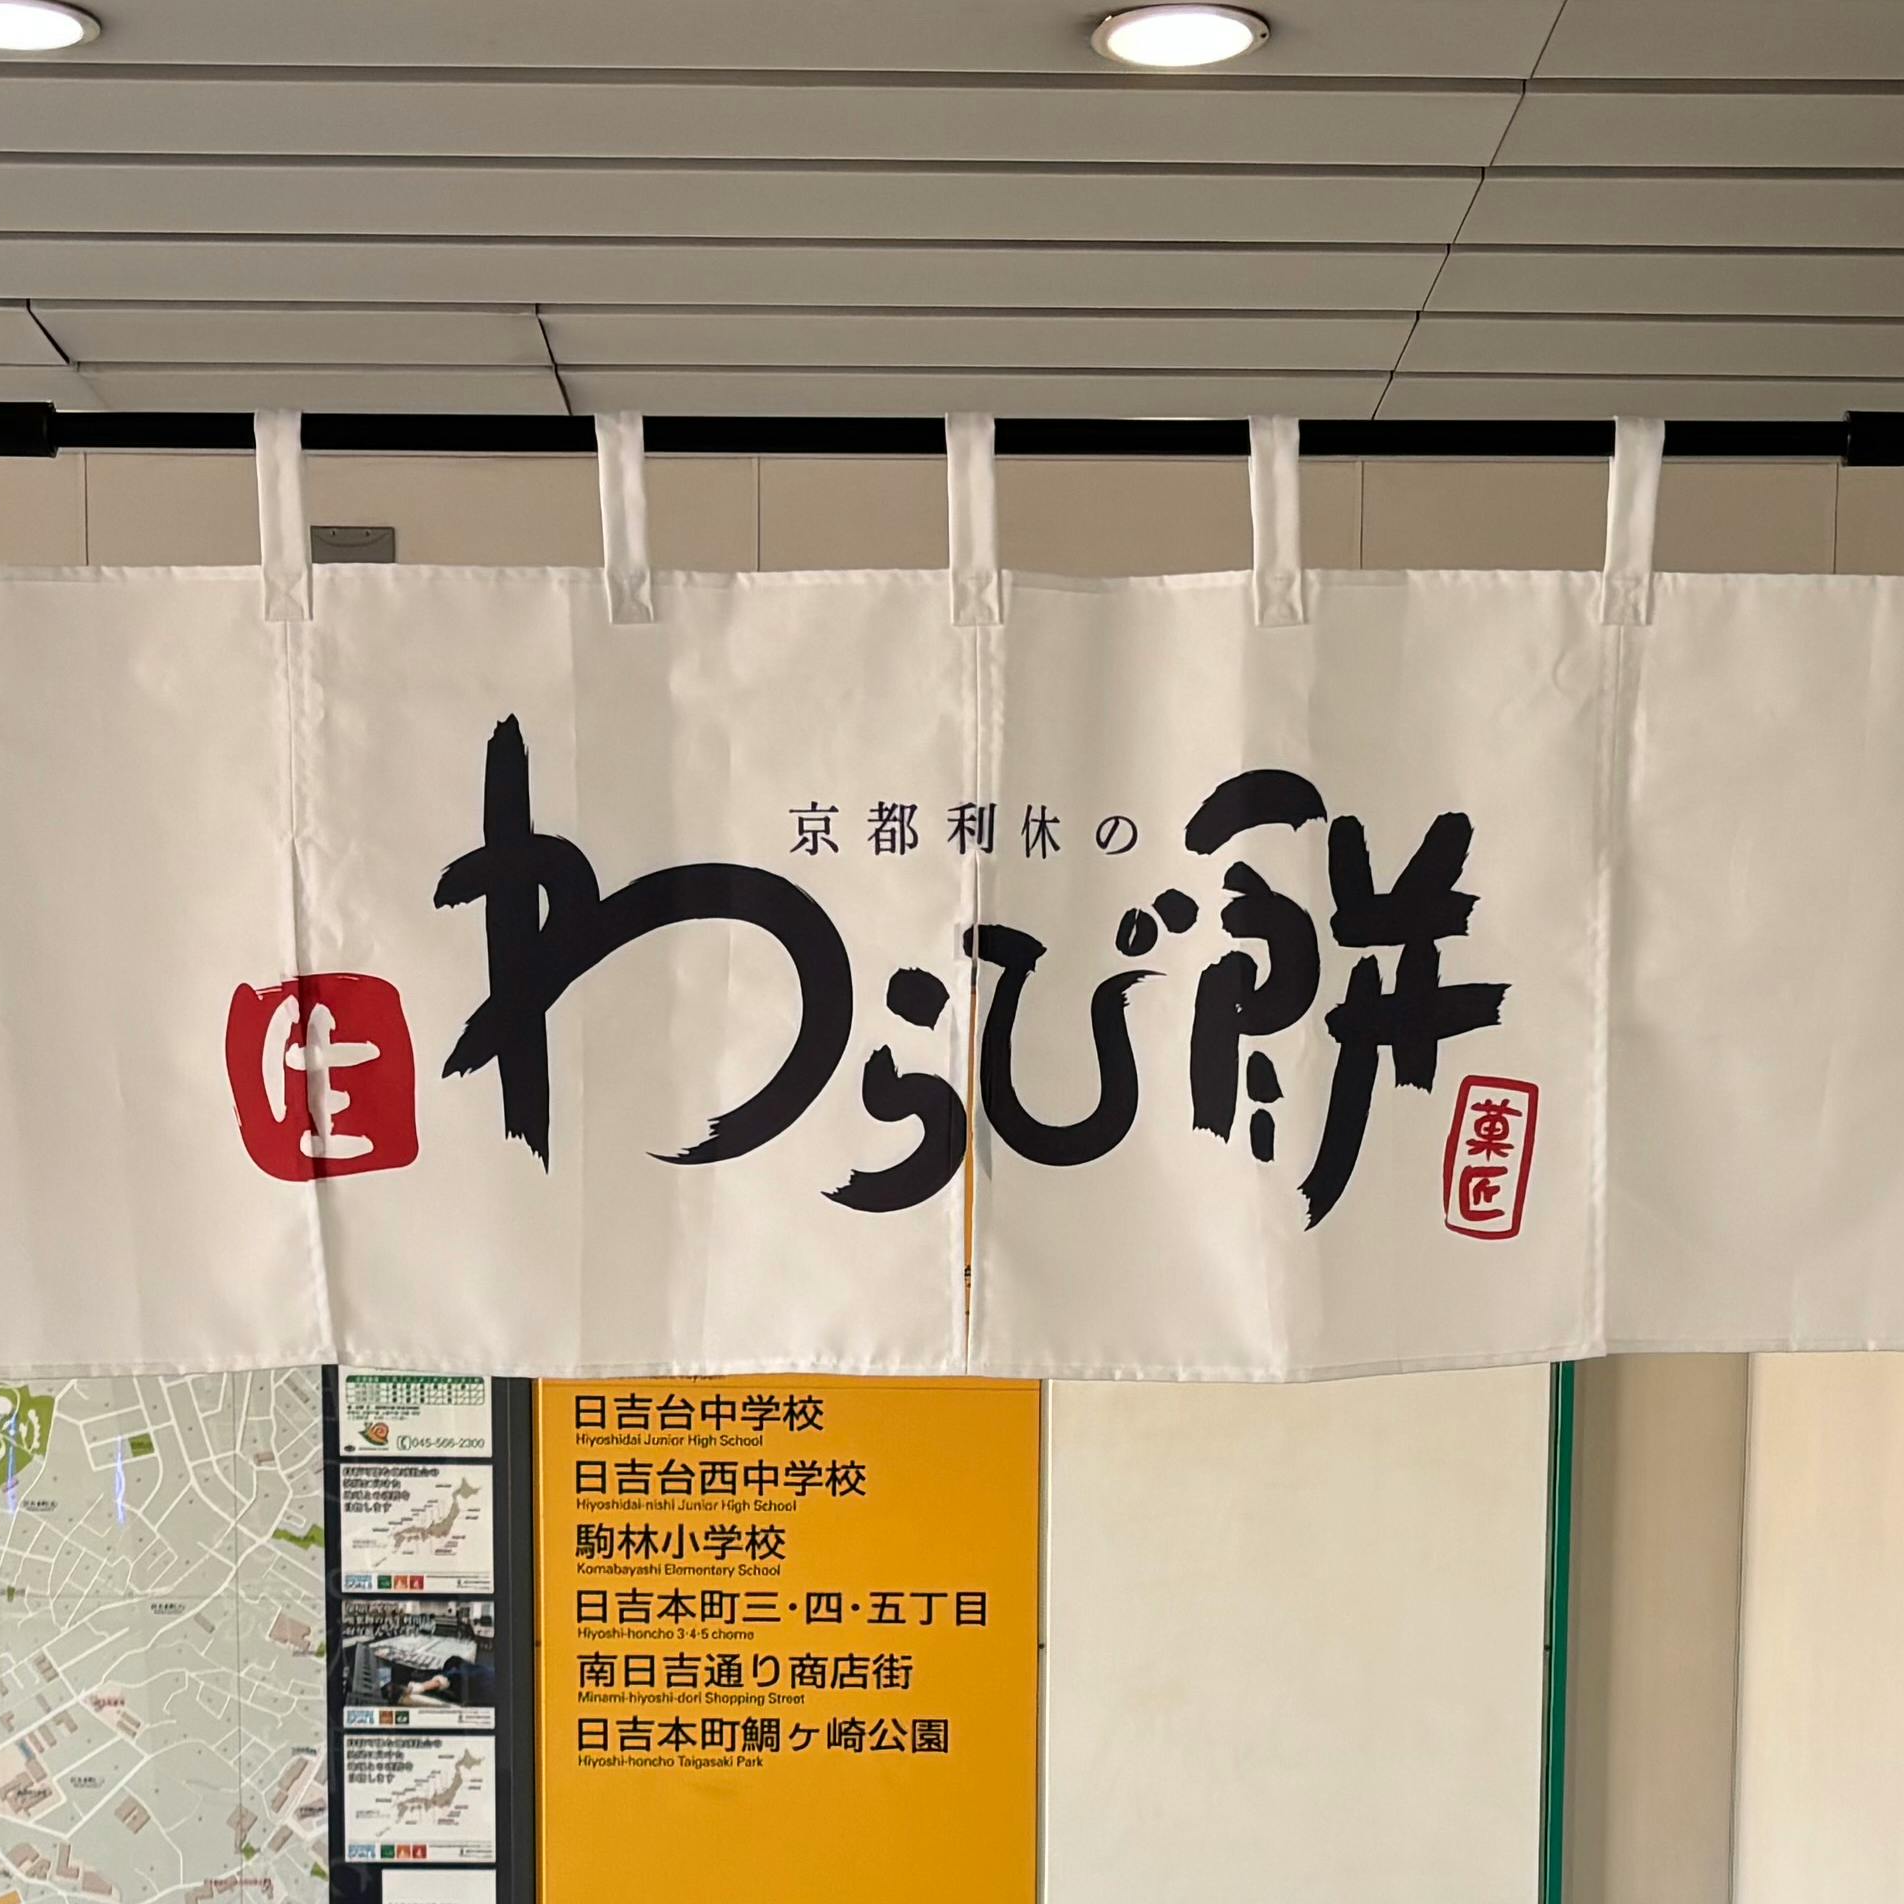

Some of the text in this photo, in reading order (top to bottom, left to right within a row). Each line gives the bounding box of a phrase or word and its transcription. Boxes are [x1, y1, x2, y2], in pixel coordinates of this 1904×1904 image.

[788, 801, 1139, 859] 京都利休の
[432, 714, 1506, 1233] わらび餅
[261, 997, 382, 1156] 生
[574, 1393, 824, 1431] 日吉台中学校
[576, 1434, 763, 1449] Hiyoshidai Junior High School
[574, 1459, 866, 1497] 日吉台西中学校
[576, 1499, 797, 1514] Hiyoshidai-nishi Junior High School
[575, 1523, 786, 1561] 駒林小学校
[577, 1563, 781, 1578] Komabayashi Elementary School
[576, 1588, 988, 1627] 日吉本町三・四・五丁目
[577, 1627, 675, 1642] Hiyoshi-honcho
[711, 1628, 755, 1641] chome
[578, 1651, 914, 1690] 南日吉通り商店街
[578, 1691, 805, 1707] Minami-hiyoshi-dori Shopping Street
[578, 1755, 764, 1770] Hiyoshi-honcho Taigasaki Park
